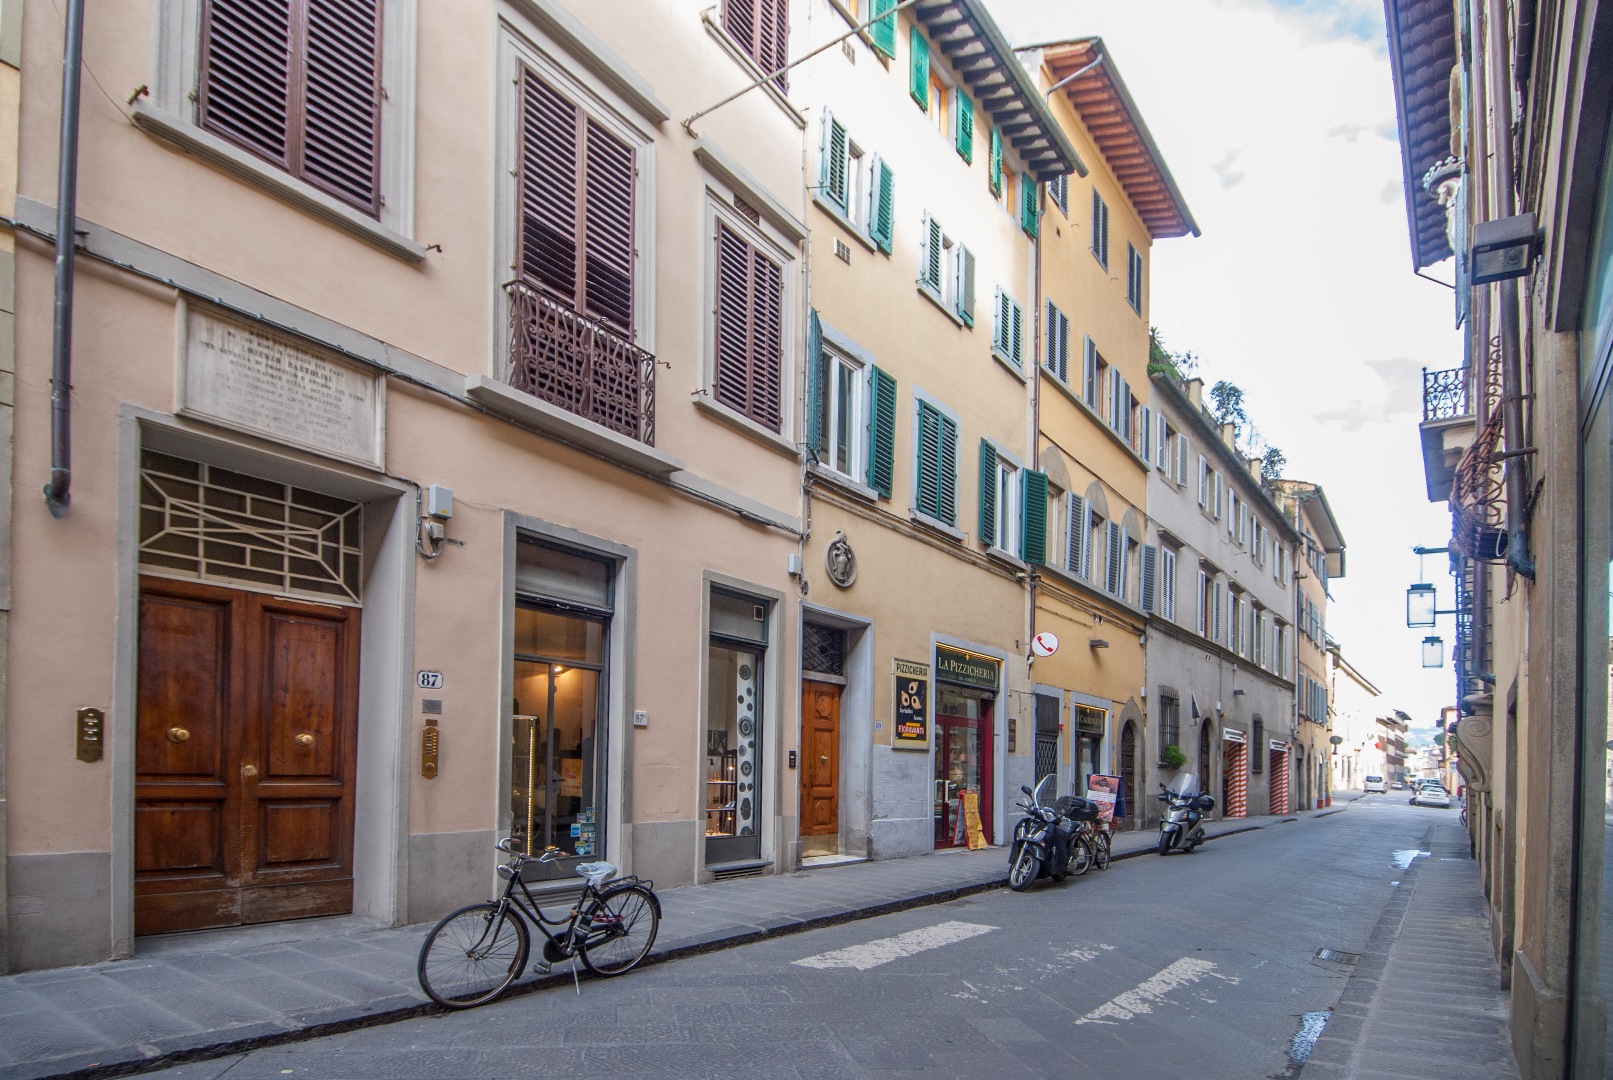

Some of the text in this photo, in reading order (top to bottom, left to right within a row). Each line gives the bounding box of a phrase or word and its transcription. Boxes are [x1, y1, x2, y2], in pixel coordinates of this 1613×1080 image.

[241, 344, 331, 383] LORENZO BARTOLINI
[896, 662, 928, 677] PIZZICHERIA
[938, 656, 994, 681] LA PIZZICHERIA
[421, 673, 439, 687] 87
[898, 725, 925, 735] FIORAVANTI
